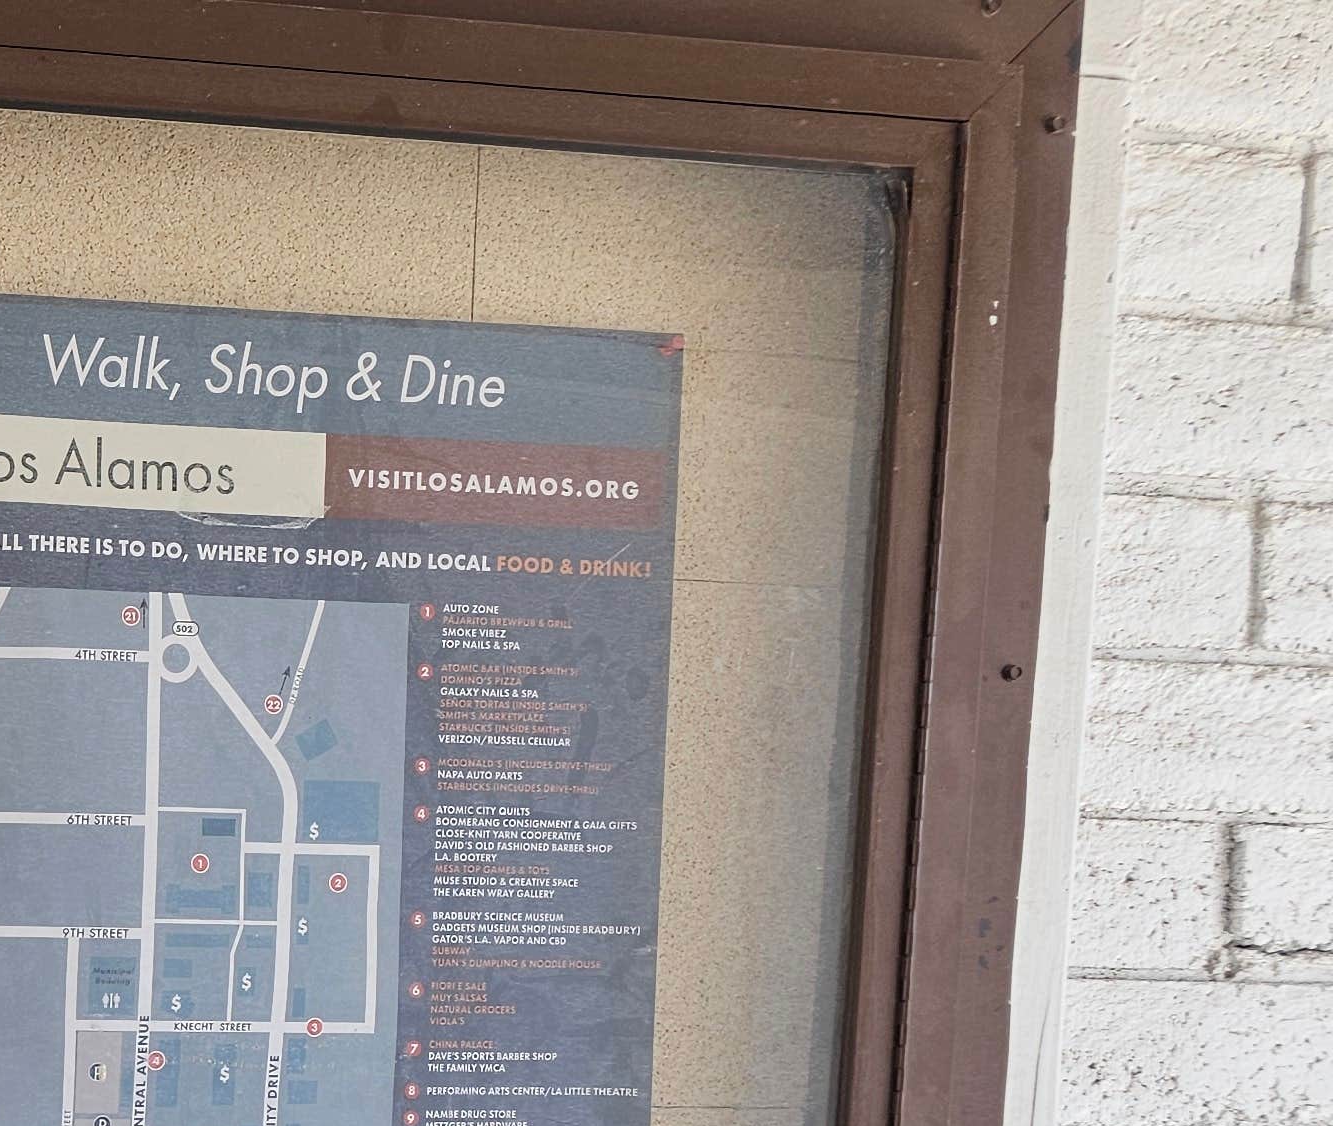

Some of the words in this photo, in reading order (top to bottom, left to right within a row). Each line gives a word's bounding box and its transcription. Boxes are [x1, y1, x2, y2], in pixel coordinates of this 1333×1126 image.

[44, 333, 181, 402] Walk,
[204, 344, 330, 414] Shop
[345, 352, 381, 401] &
[400, 356, 507, 408] Dine
[55, 438, 235, 495] Alamos
[349, 469, 639, 499] VISITLOSALAMOS.ORG
[29, 535, 89, 554] THERE
[96, 538, 113, 555] IS
[119, 540, 145, 556] TO
[152, 542, 188, 562] DO,
[197, 543, 267, 563] WHERE
[273, 547, 299, 564] TO
[306, 548, 367, 575] SHOP,
[376, 552, 421, 568] AND
[428, 554, 490, 571] LOCAL
[498, 556, 553, 573] FOOD
[561, 559, 572, 574] &
[581, 560, 649, 576] DRINK!
[443, 604, 469, 613] AUTO
[472, 604, 498, 614] ZONE
[75, 650, 96, 661] 4TH
[100, 651, 137, 662] STREET
